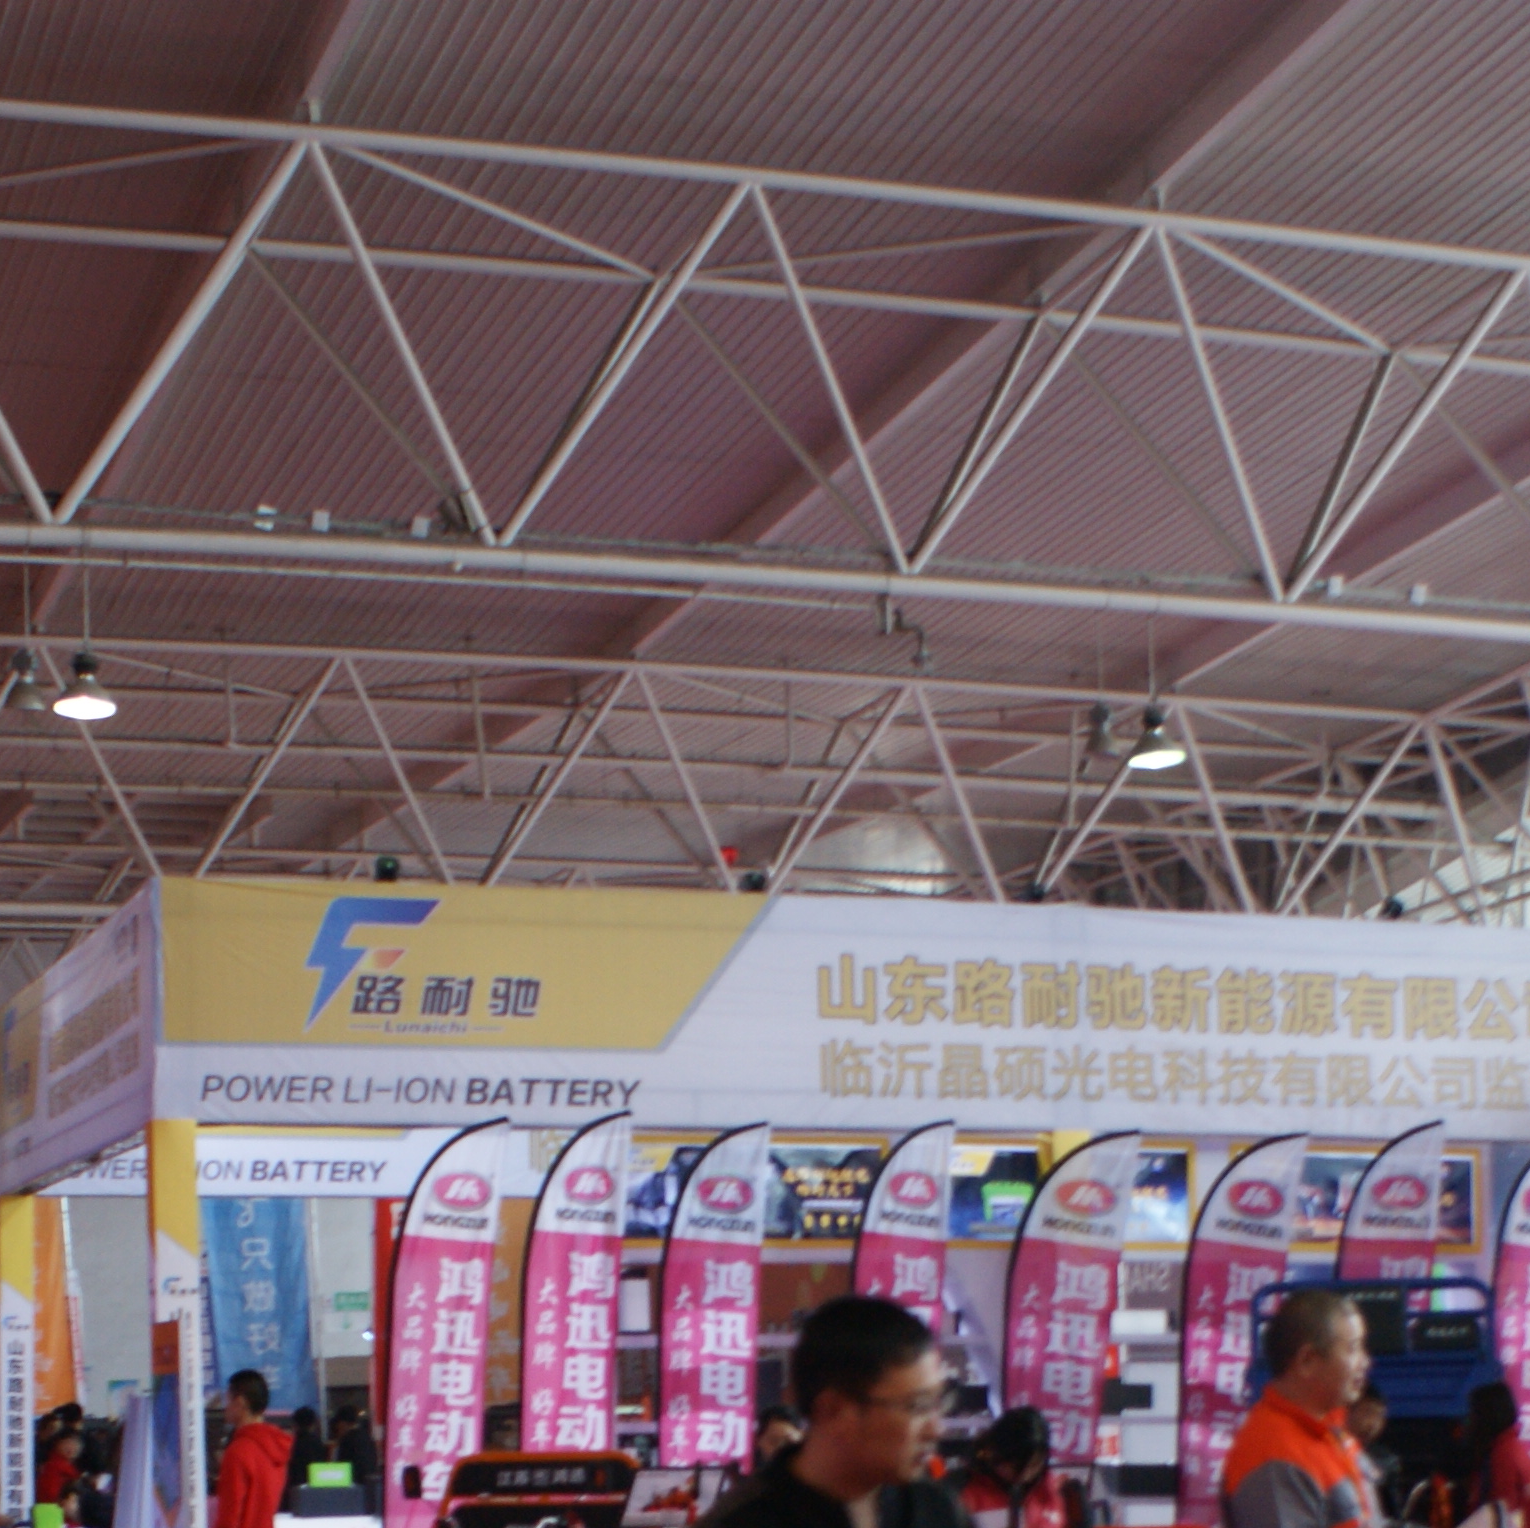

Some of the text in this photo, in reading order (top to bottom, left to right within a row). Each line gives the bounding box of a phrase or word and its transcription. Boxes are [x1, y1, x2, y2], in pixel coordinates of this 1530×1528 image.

[351, 974, 541, 1018] 路耐驰
[200, 1072, 333, 1104] POWER
[464, 1077, 643, 1107] BATTERY
[73, 1159, 146, 1181] OWER
[250, 1161, 387, 1183] BATTERY
